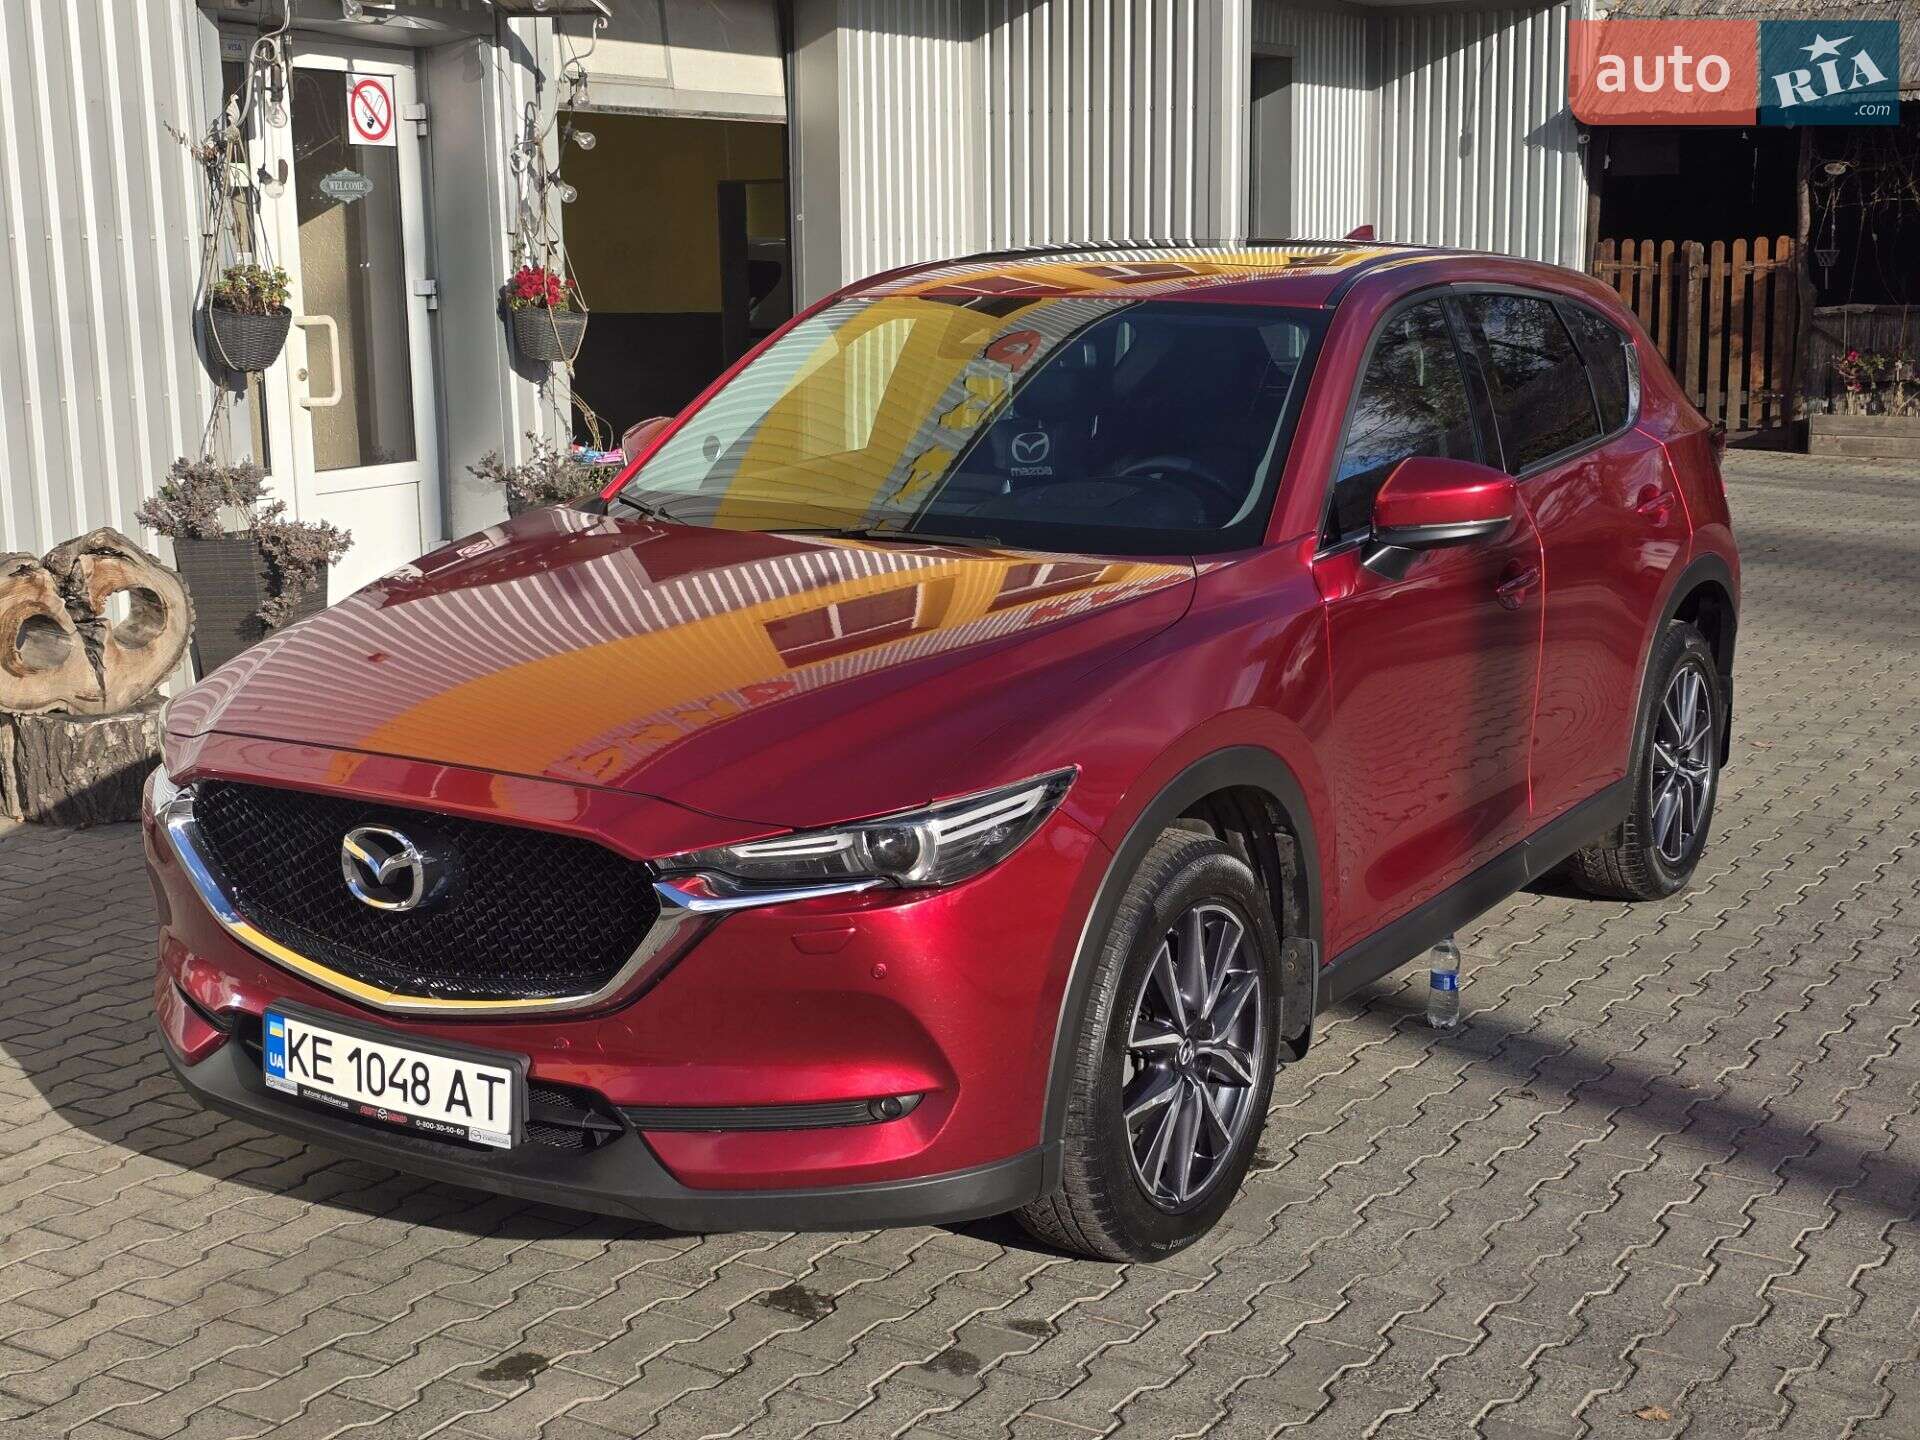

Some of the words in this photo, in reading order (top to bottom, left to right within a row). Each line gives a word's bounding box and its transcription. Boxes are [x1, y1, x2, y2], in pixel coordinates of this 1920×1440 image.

[327, 180, 365, 191] WELCOME
[269, 1051, 284, 1070] UA
[287, 1027, 334, 1084] KE
[347, 1047, 431, 1106] 1048
[445, 1069, 505, 1121] AT
